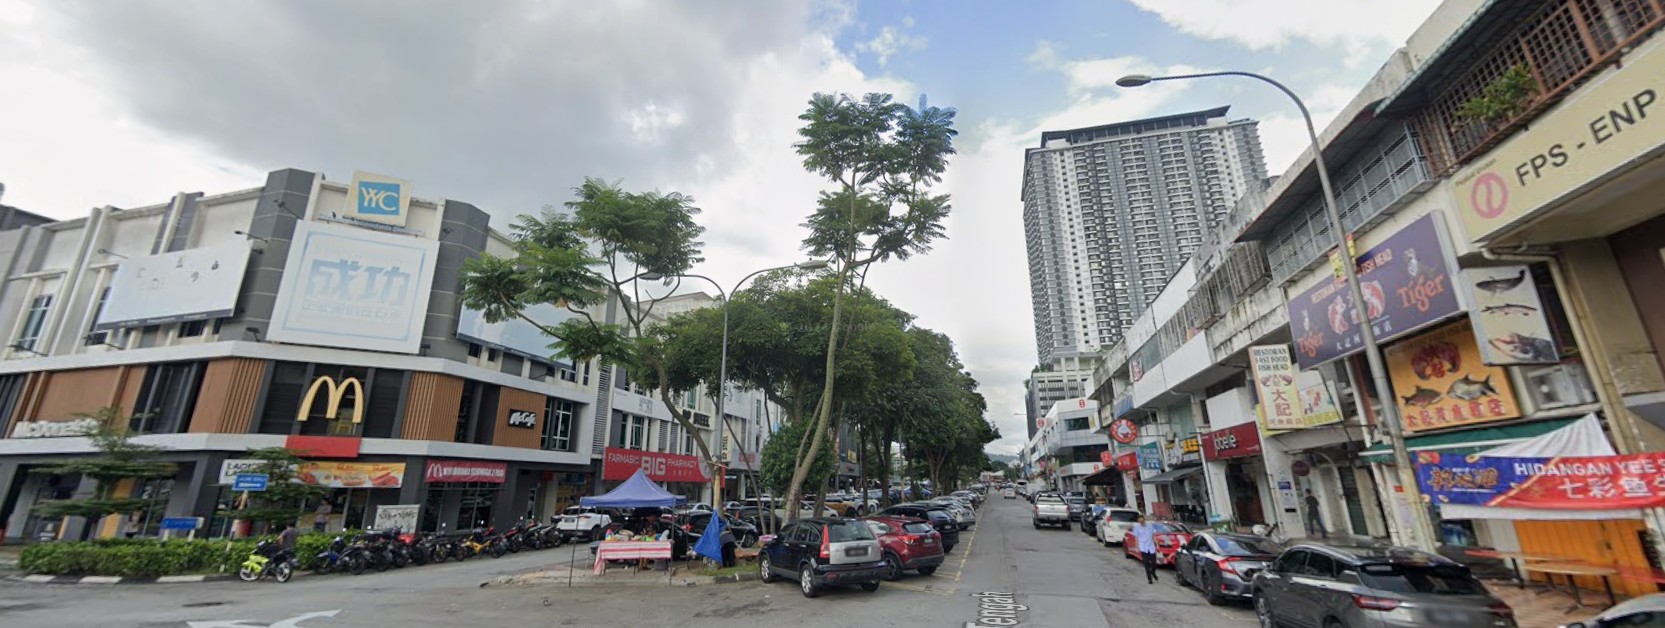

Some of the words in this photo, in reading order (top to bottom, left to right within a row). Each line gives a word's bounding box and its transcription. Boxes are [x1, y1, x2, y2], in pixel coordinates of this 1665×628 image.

[1515, 144, 1569, 187] FPS
[1589, 88, 1657, 144] ENP
[1398, 272, 1446, 313] Tiger
[1253, 348, 1288, 356] RESTORAN
[1297, 330, 1324, 358] Tiger
[1255, 356, 1270, 364] FAST
[1271, 355, 1288, 363] FOOD
[641, 456, 666, 475] BIG
[666, 458, 697, 468] PHARMACY
[1513, 461, 1613, 477] HIDANGAN
[1616, 459, 1657, 474] YEE
